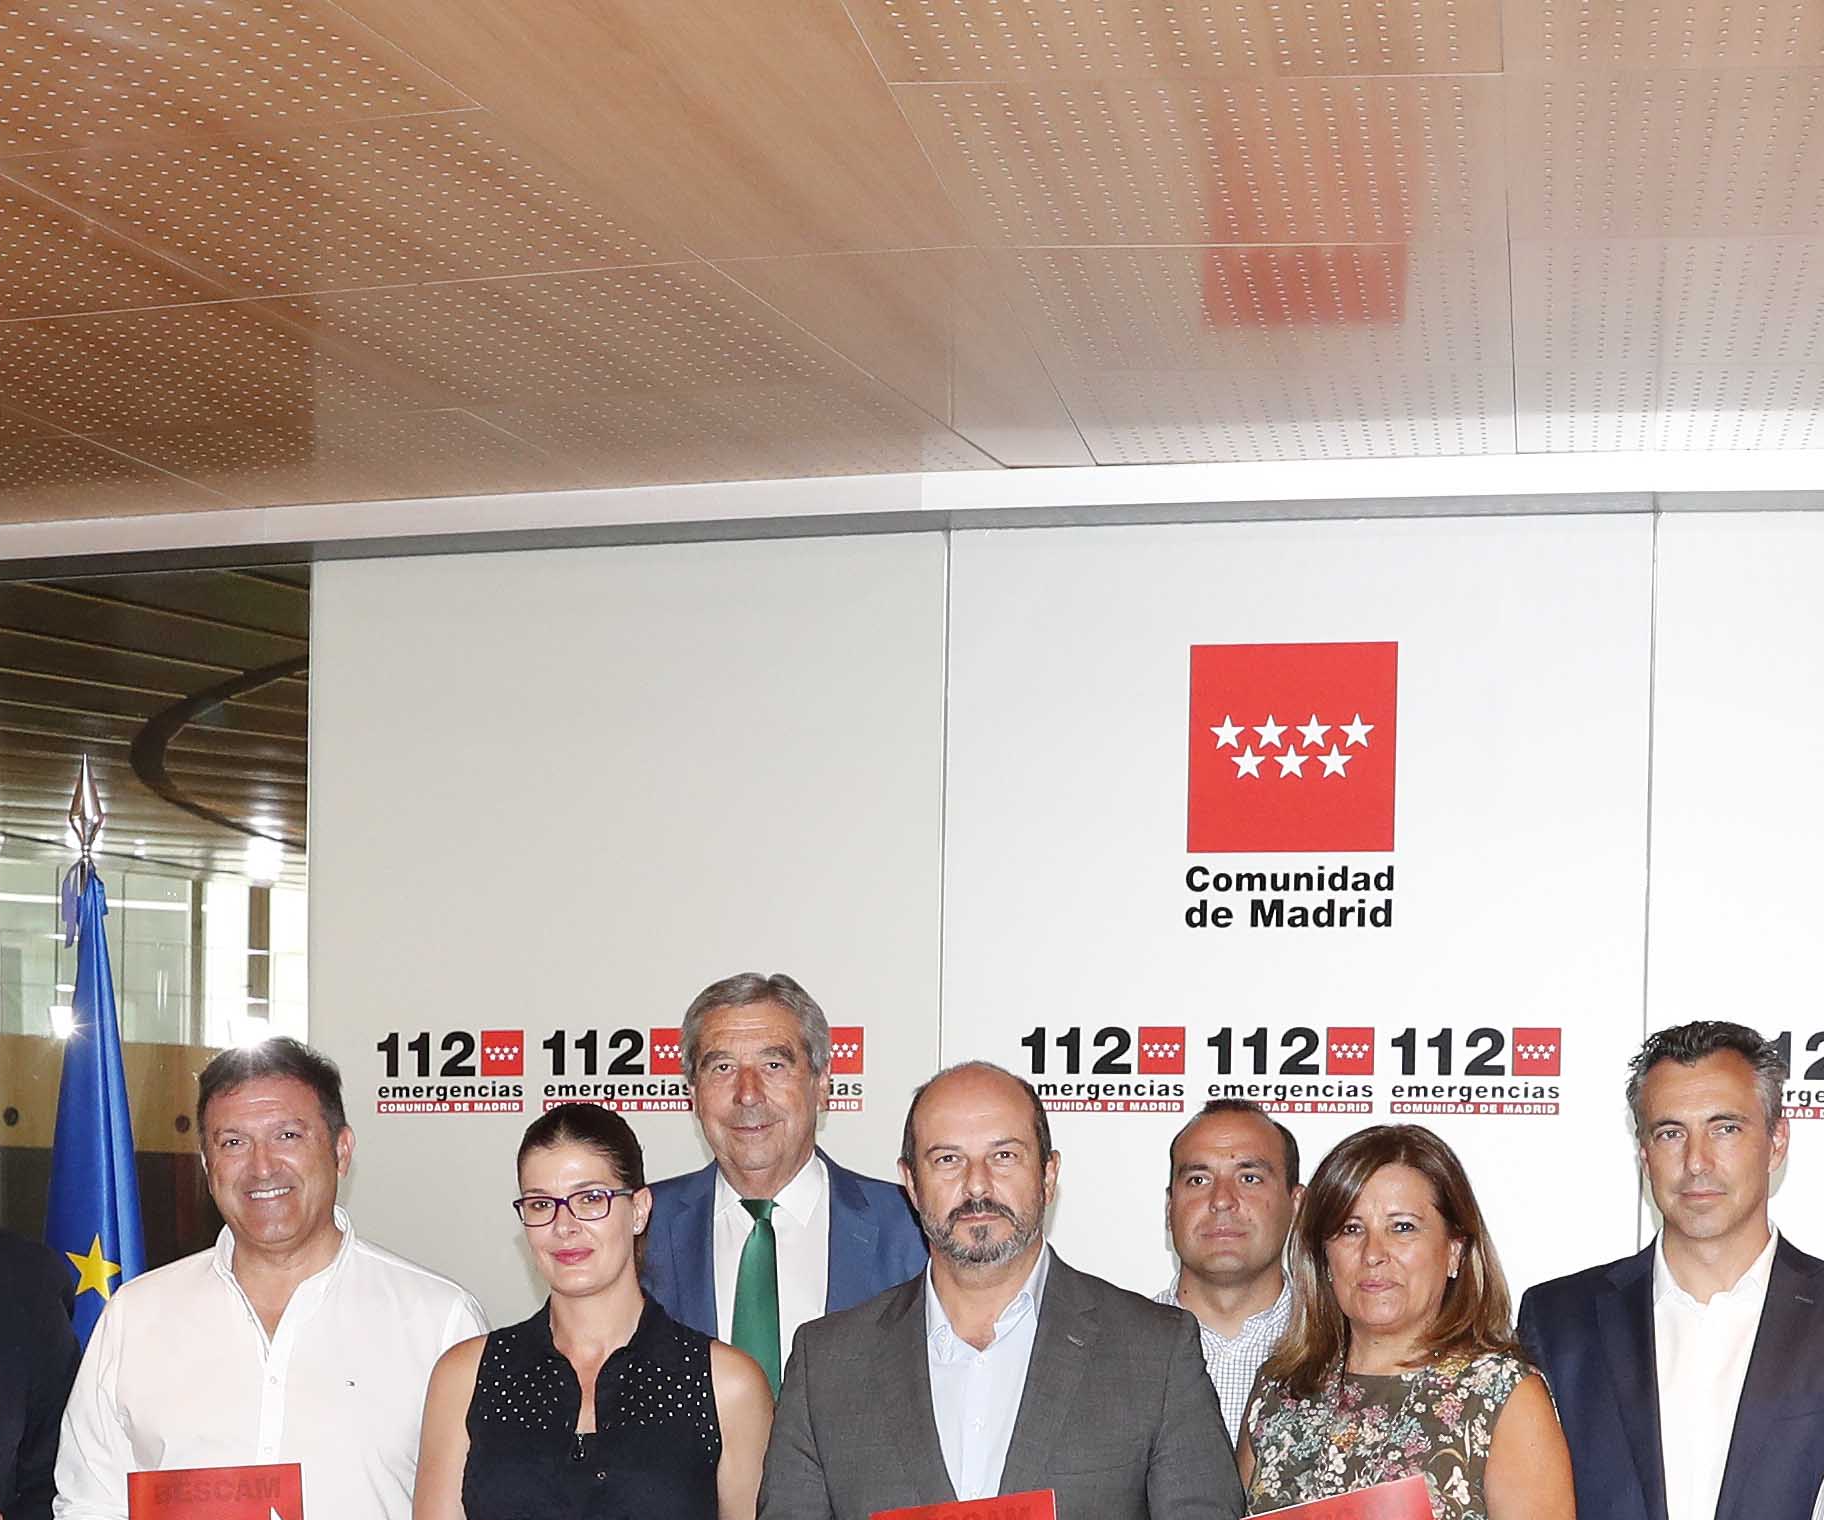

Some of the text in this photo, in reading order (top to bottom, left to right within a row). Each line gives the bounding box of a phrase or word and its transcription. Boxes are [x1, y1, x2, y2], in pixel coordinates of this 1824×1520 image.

[1185, 865, 1395, 892] Comunidad
[1184, 898, 1393, 928] de Madrid
[376, 1030, 476, 1078] 112
[542, 1028, 645, 1076] 112
[1021, 1026, 1132, 1075] 112
[1207, 1026, 1320, 1075] 112
[1390, 1027, 1506, 1076] 112
[377, 1080, 524, 1101] emergencias
[1037, 1079, 1185, 1100] mergencias
[1207, 1080, 1374, 1101] emergencias
[1390, 1081, 1560, 1102] emergencias
[379, 1102, 520, 1112] COMUNIDAD DE MADRID
[622, 1101, 638, 1110] DE
[642, 1101, 689, 1110] MADRID
[828, 1101, 859, 1110] DRID
[1043, 1102, 1181, 1111] MUNIDAD DE MADRID
[1293, 1102, 1314, 1112] DE
[1317, 1102, 1370, 1113] MADRID
[1393, 1103, 1557, 1115] COMUNIDAD DE MADRID
